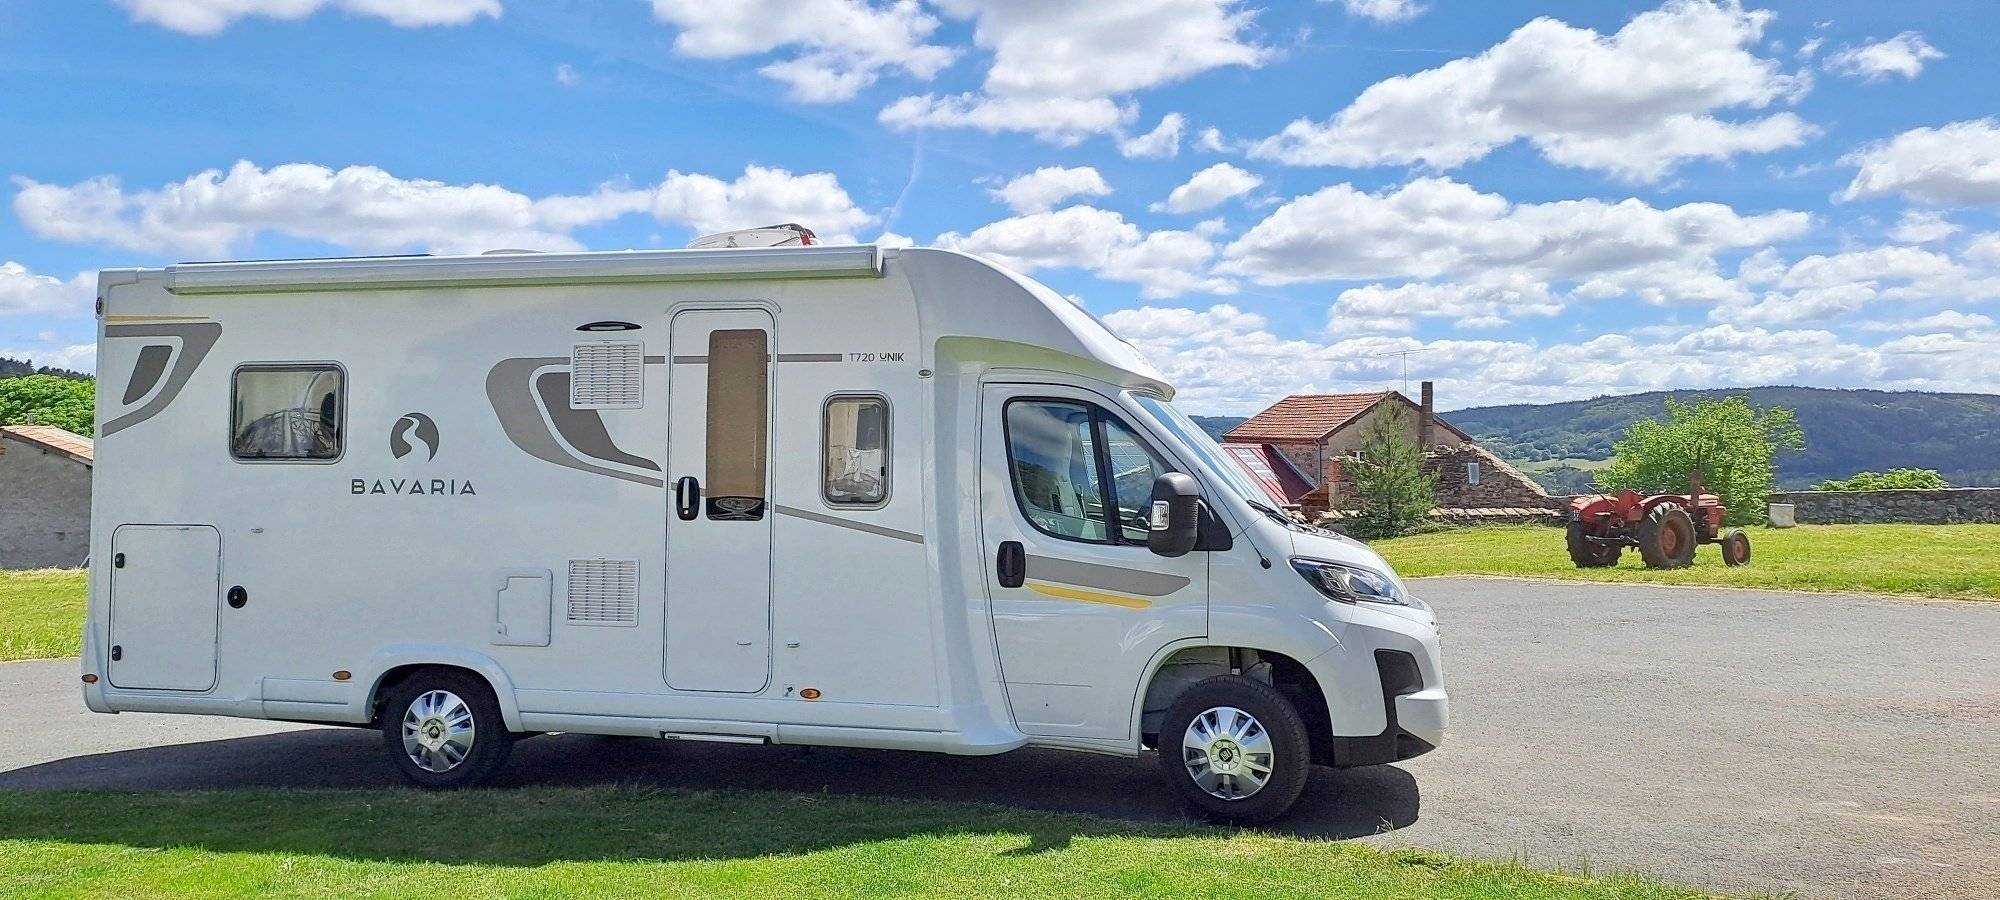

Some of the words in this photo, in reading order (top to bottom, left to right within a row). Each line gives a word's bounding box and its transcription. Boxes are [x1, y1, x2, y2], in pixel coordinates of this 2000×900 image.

[849, 352, 875, 362] T720
[879, 352, 905, 362] UNIK
[351, 478, 477, 495] BAVARIA
